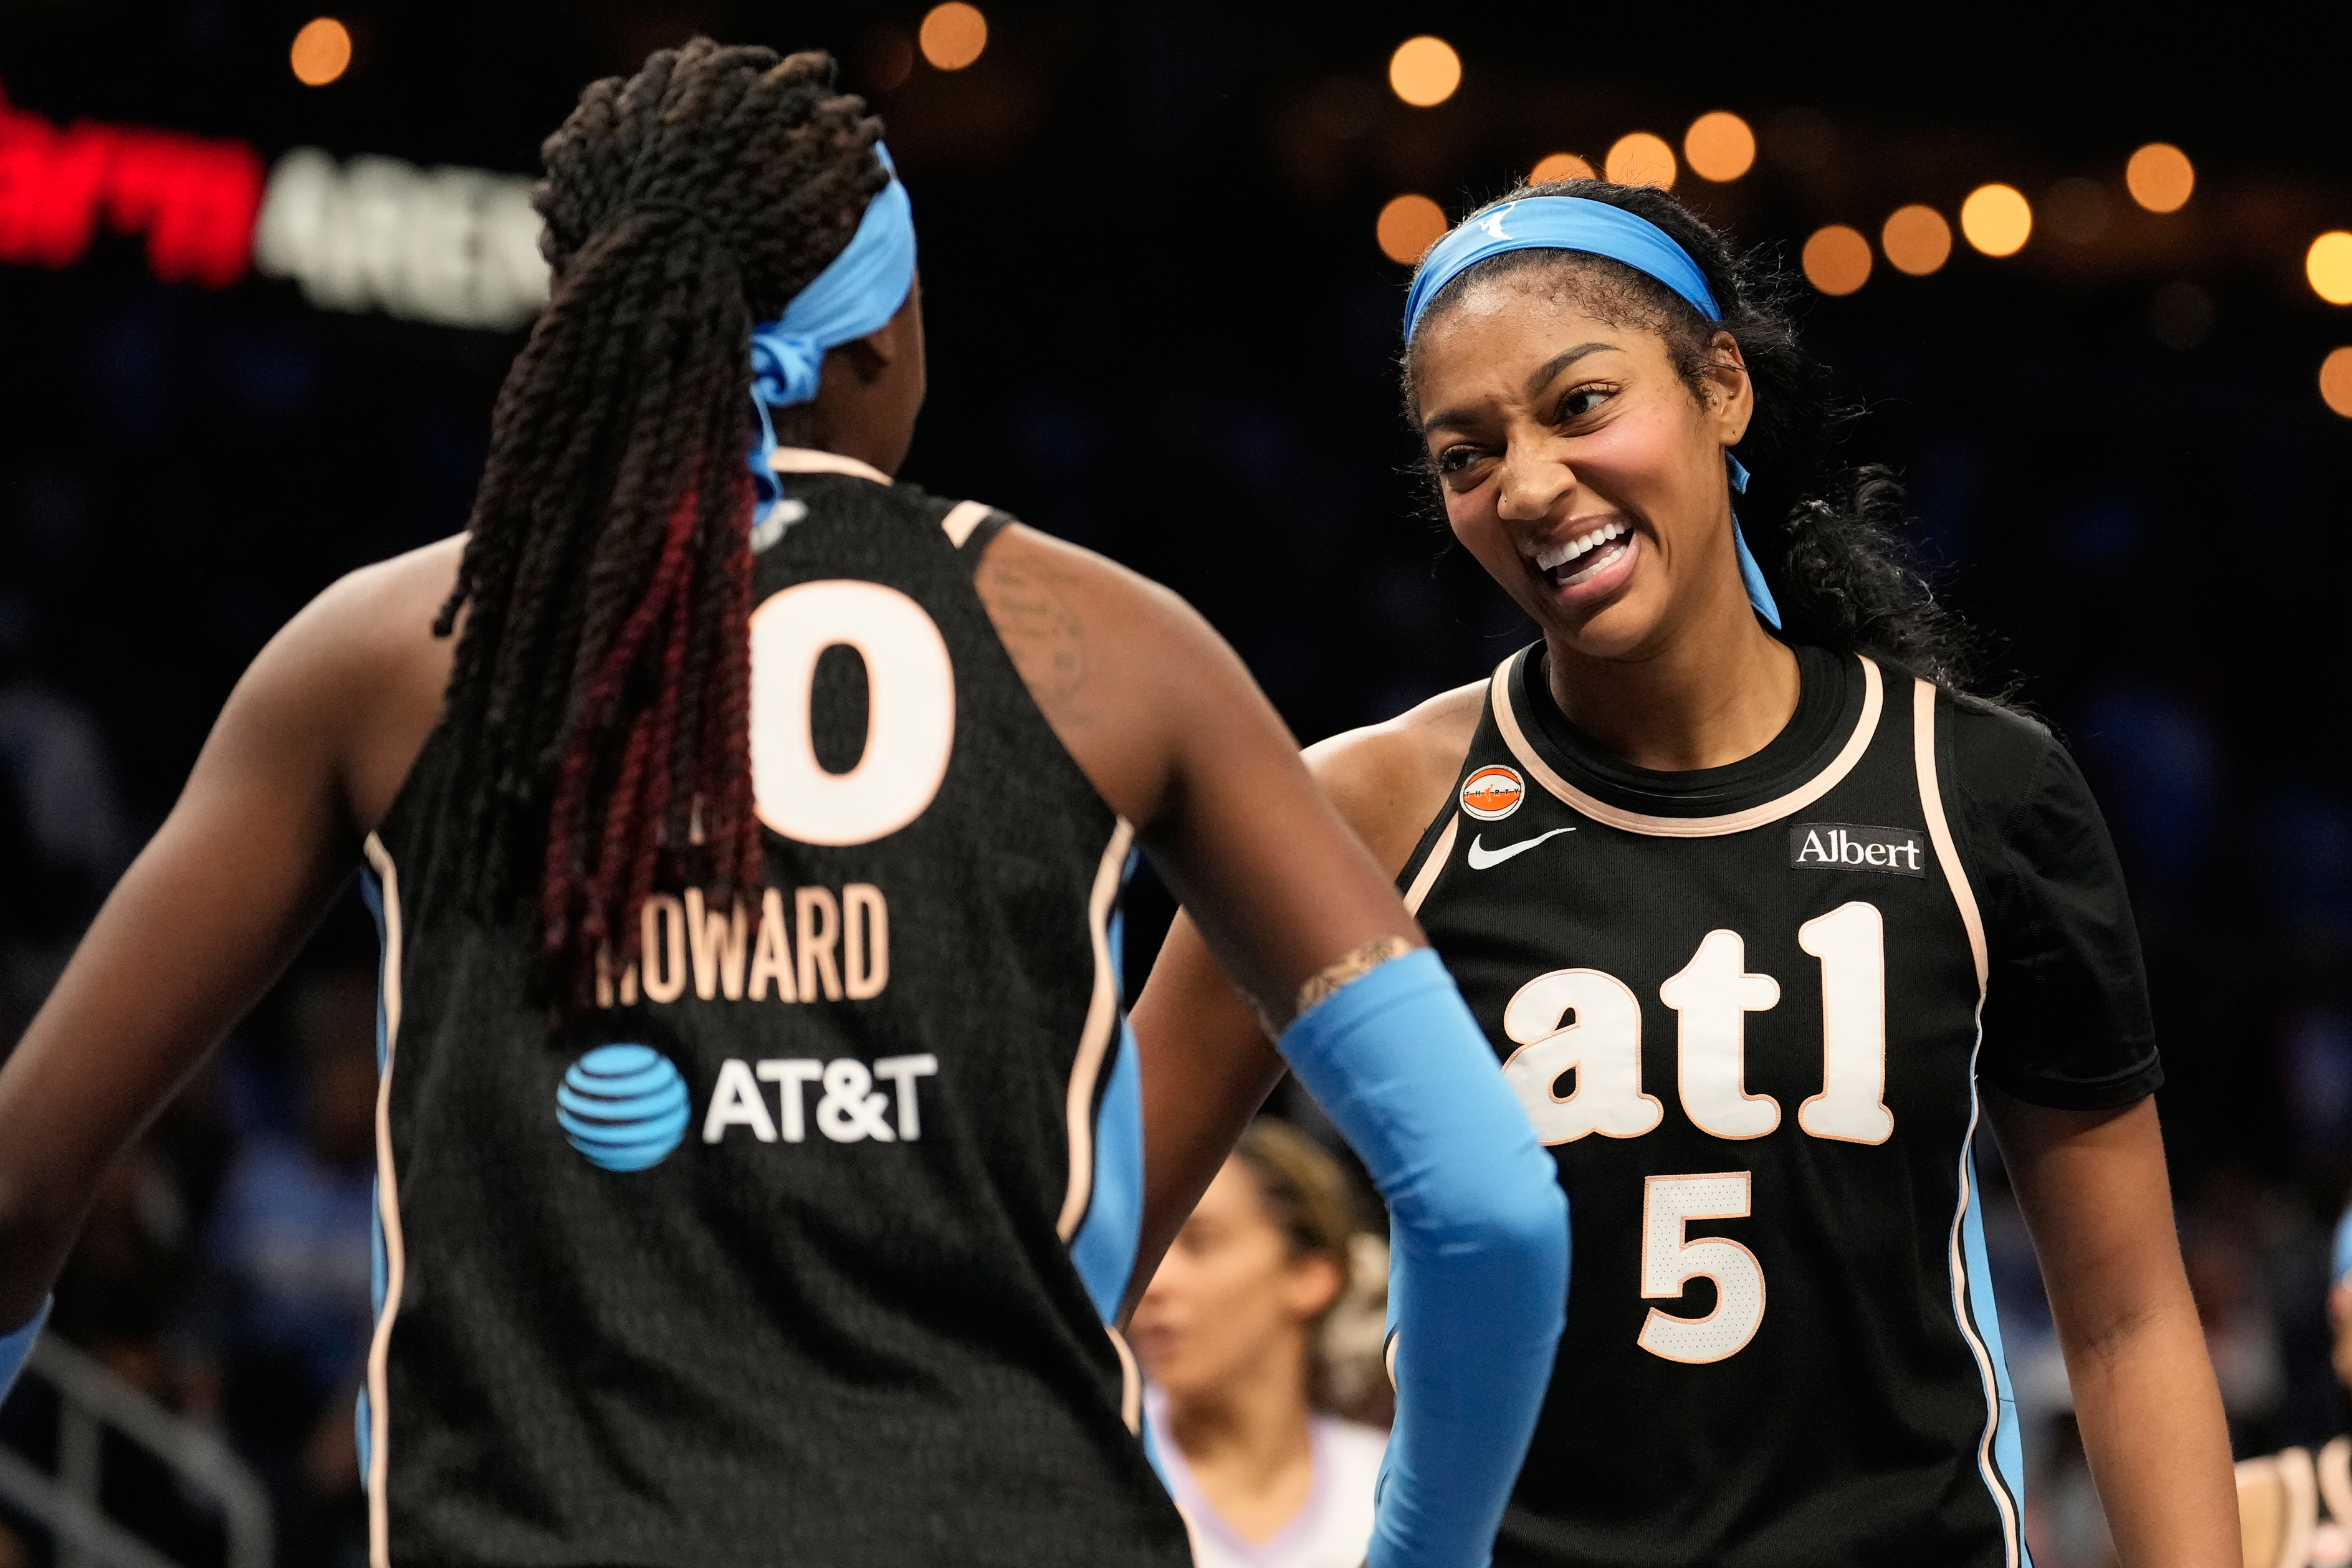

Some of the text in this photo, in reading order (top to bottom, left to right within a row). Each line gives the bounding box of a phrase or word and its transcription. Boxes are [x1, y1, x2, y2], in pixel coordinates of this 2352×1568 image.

[689, 578, 956, 847] 0
[1795, 829, 1921, 870] Albert
[702, 1053, 939, 1144] AT&T
[1503, 901, 1893, 1145] atl
[1637, 1170, 1766, 1364] 5
